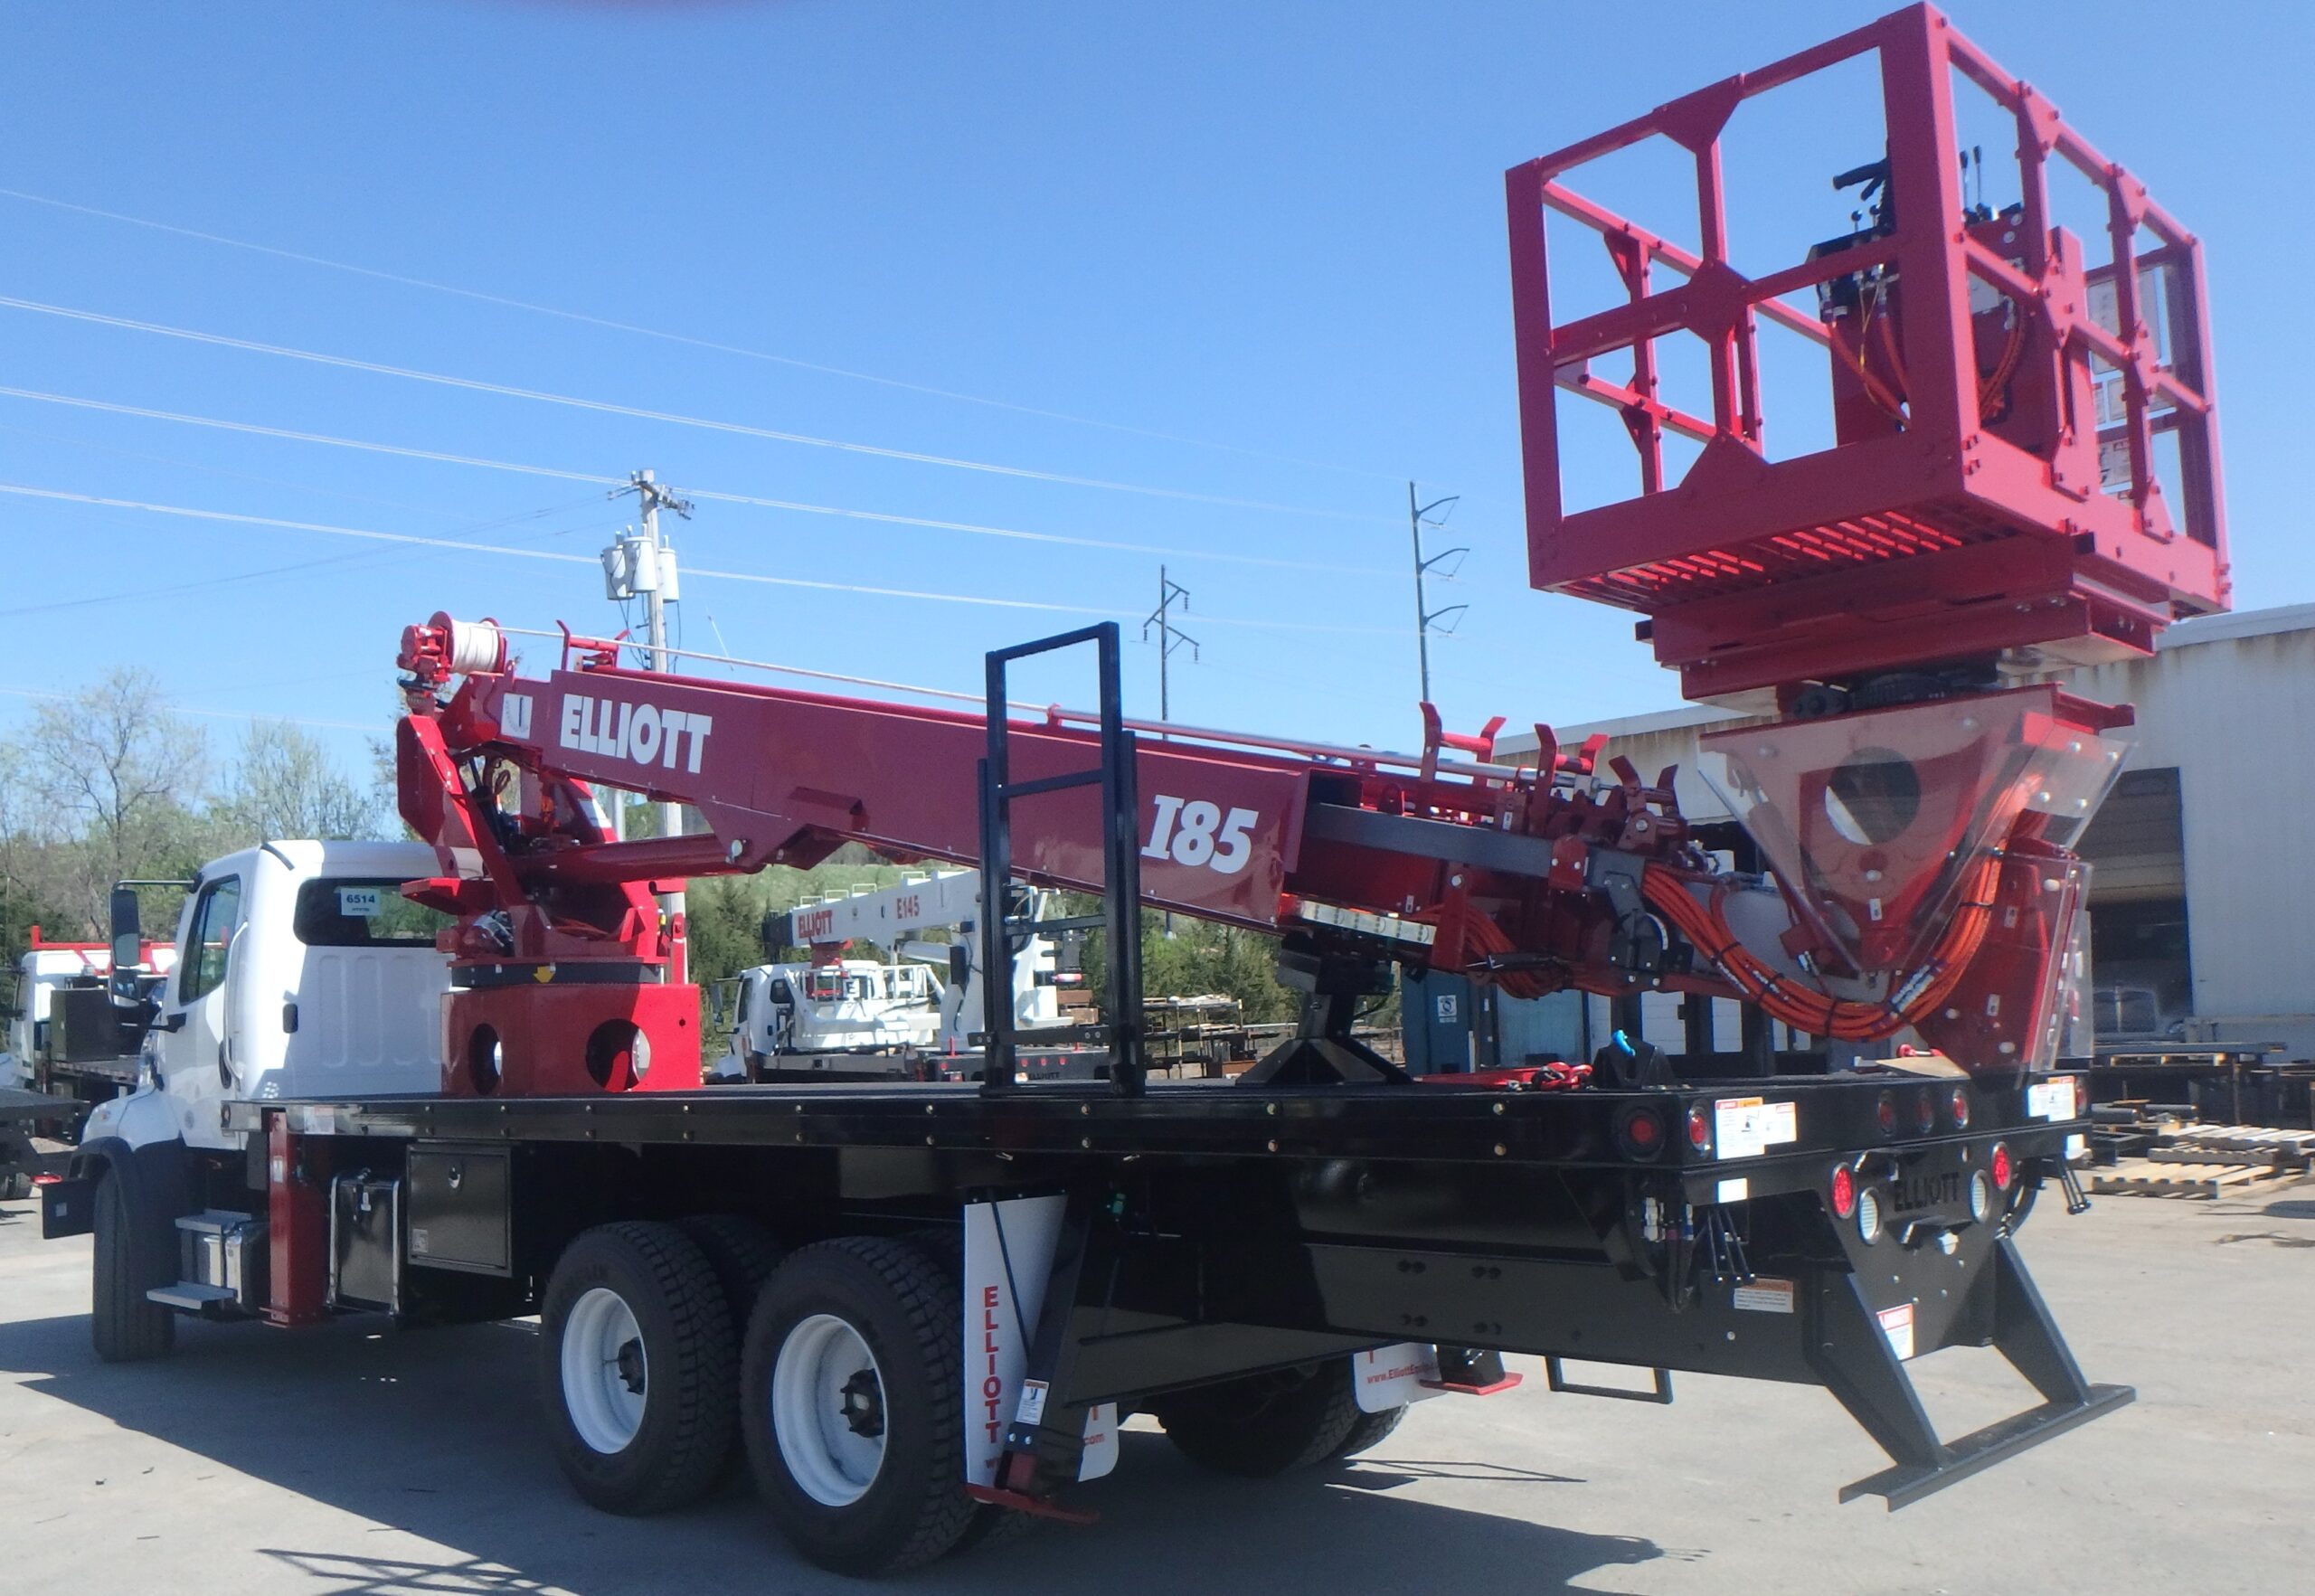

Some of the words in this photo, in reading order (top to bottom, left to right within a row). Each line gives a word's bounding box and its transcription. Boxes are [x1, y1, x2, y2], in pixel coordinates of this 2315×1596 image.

[561, 693, 713, 774] ELLIOTT
[346, 894, 375, 903] 6514
[896, 895, 920, 920] E145
[798, 909, 833, 939] ELLIOTT
[1895, 1172, 1959, 1212] ELLIOTT
[983, 1285, 1001, 1444] ELLIOTT
